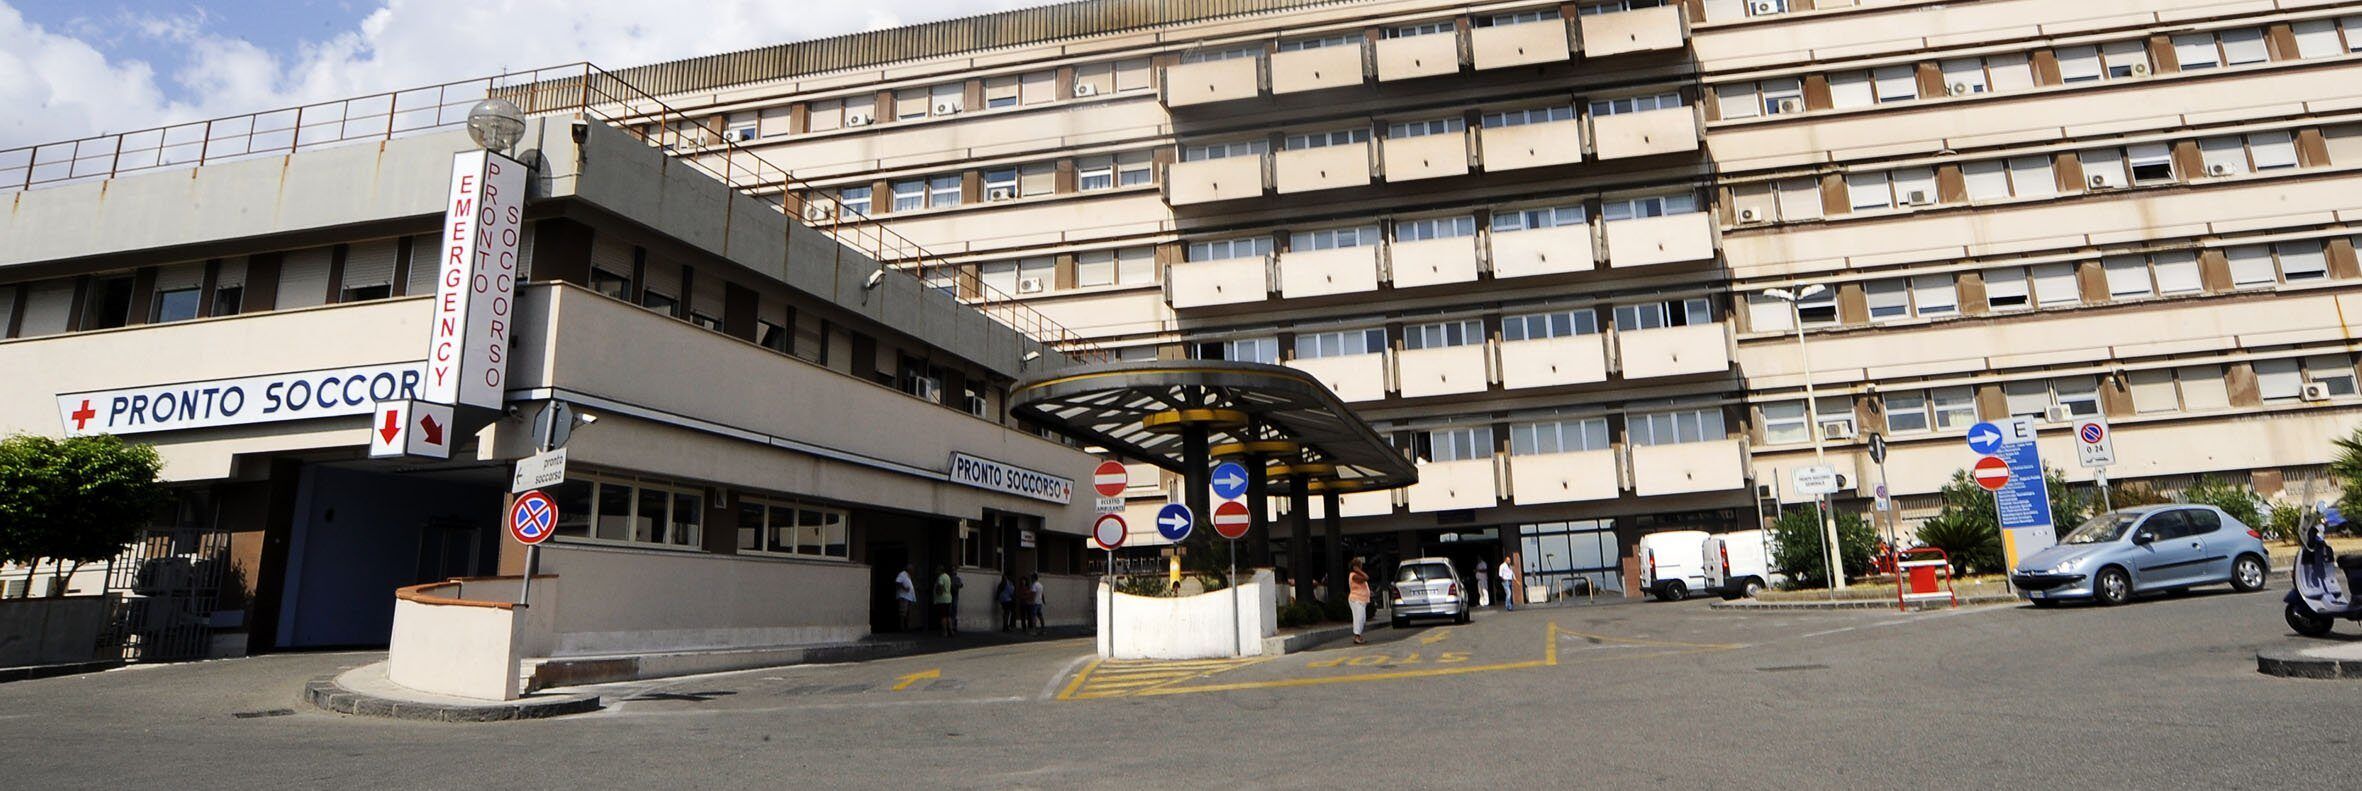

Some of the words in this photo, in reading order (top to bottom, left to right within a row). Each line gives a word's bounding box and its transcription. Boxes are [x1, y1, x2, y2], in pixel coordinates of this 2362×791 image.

[473, 162, 500, 293] PRONTO
[435, 175, 474, 387] EMERGENCY
[485, 206, 519, 387] SOCCORSO
[108, 386, 245, 427] PRONTO
[2013, 421, 2028, 438] E
[535, 470, 562, 484] soccorso
[543, 455, 563, 471] pronto
[957, 457, 1001, 486] PRONTO
[1007, 469, 1061, 498] SOCCORSO
